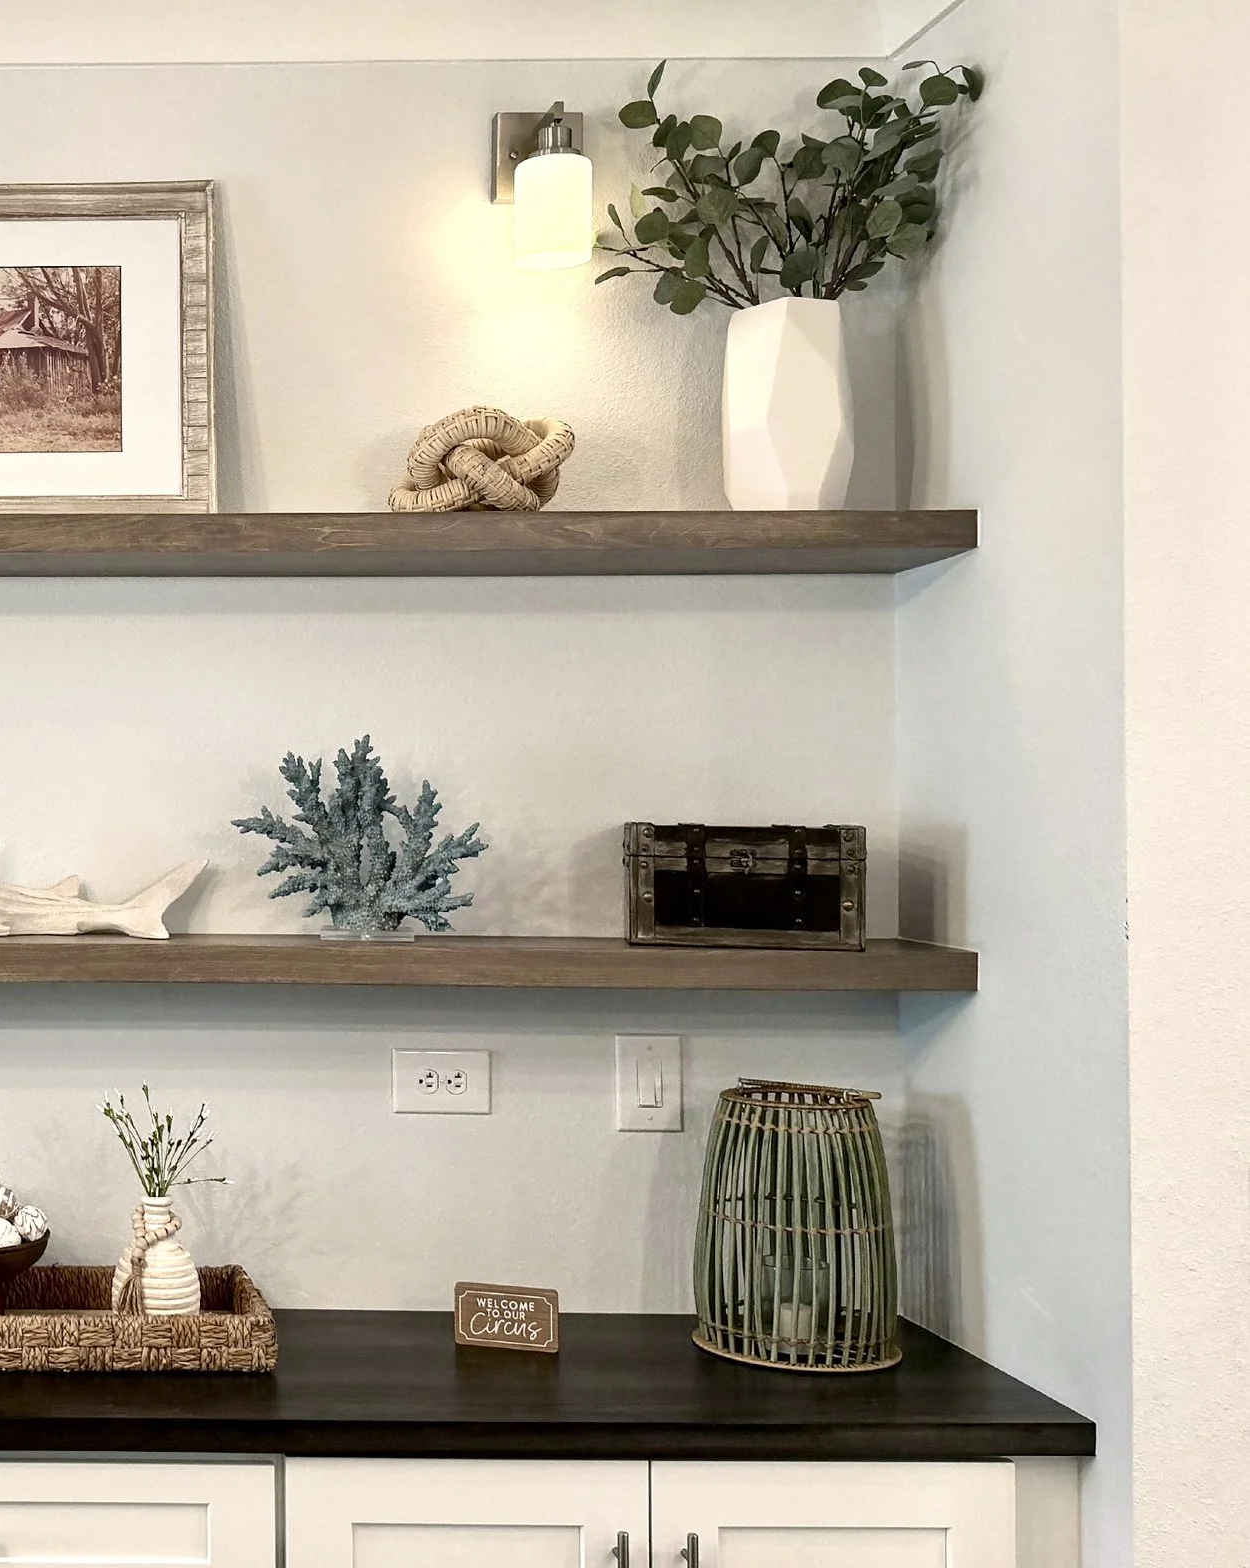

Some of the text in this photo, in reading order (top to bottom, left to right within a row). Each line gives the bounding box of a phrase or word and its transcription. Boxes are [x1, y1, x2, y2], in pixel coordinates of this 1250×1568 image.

[477, 1297, 535, 1312] WELCOME
[487, 1309, 526, 1320] TO OUR
[470, 1313, 542, 1340] Circus
